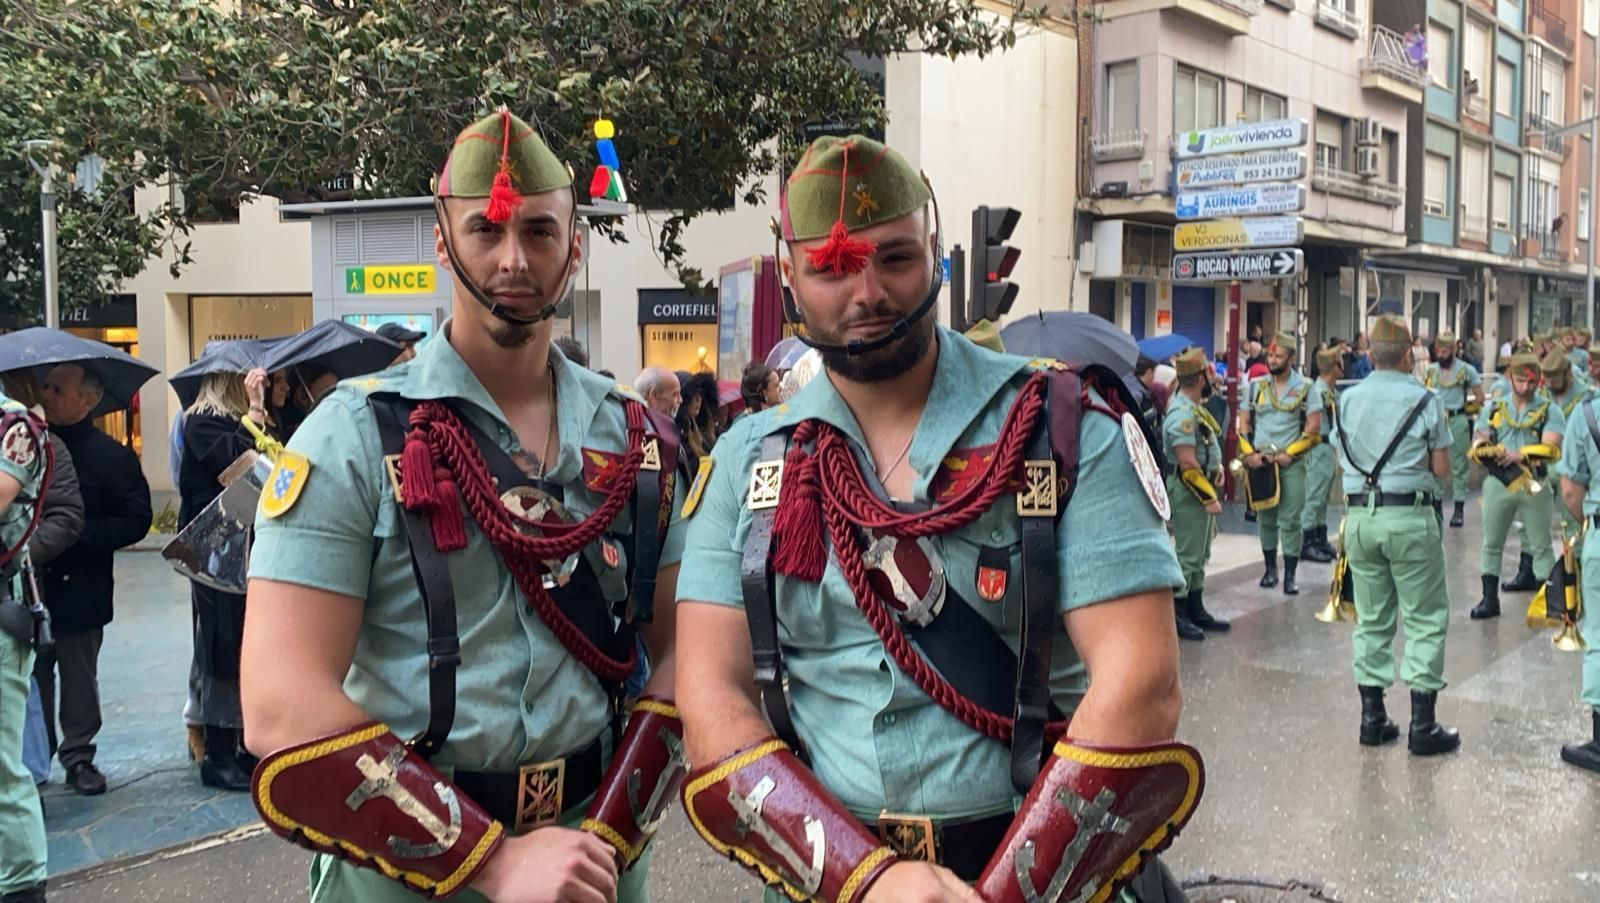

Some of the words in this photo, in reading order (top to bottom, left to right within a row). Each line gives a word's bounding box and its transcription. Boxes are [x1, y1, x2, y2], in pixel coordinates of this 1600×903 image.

[1180, 161, 1204, 171] ESPACIO
[1205, 158, 1240, 169] RESERVADO
[1241, 157, 1257, 166] PARA
[1258, 155, 1267, 165] SU
[1268, 152, 1298, 164] EMPRESA
[1243, 170, 1259, 178] 953
[1261, 169, 1272, 177] 24
[1274, 168, 1285, 176] 17
[1287, 166, 1297, 175] 01
[1204, 196, 1257, 209] AURINGIS
[1181, 234, 1247, 247] VERCOCINAS
[372, 271, 428, 289] ONCE
[653, 303, 717, 317] CORTEFIEL
